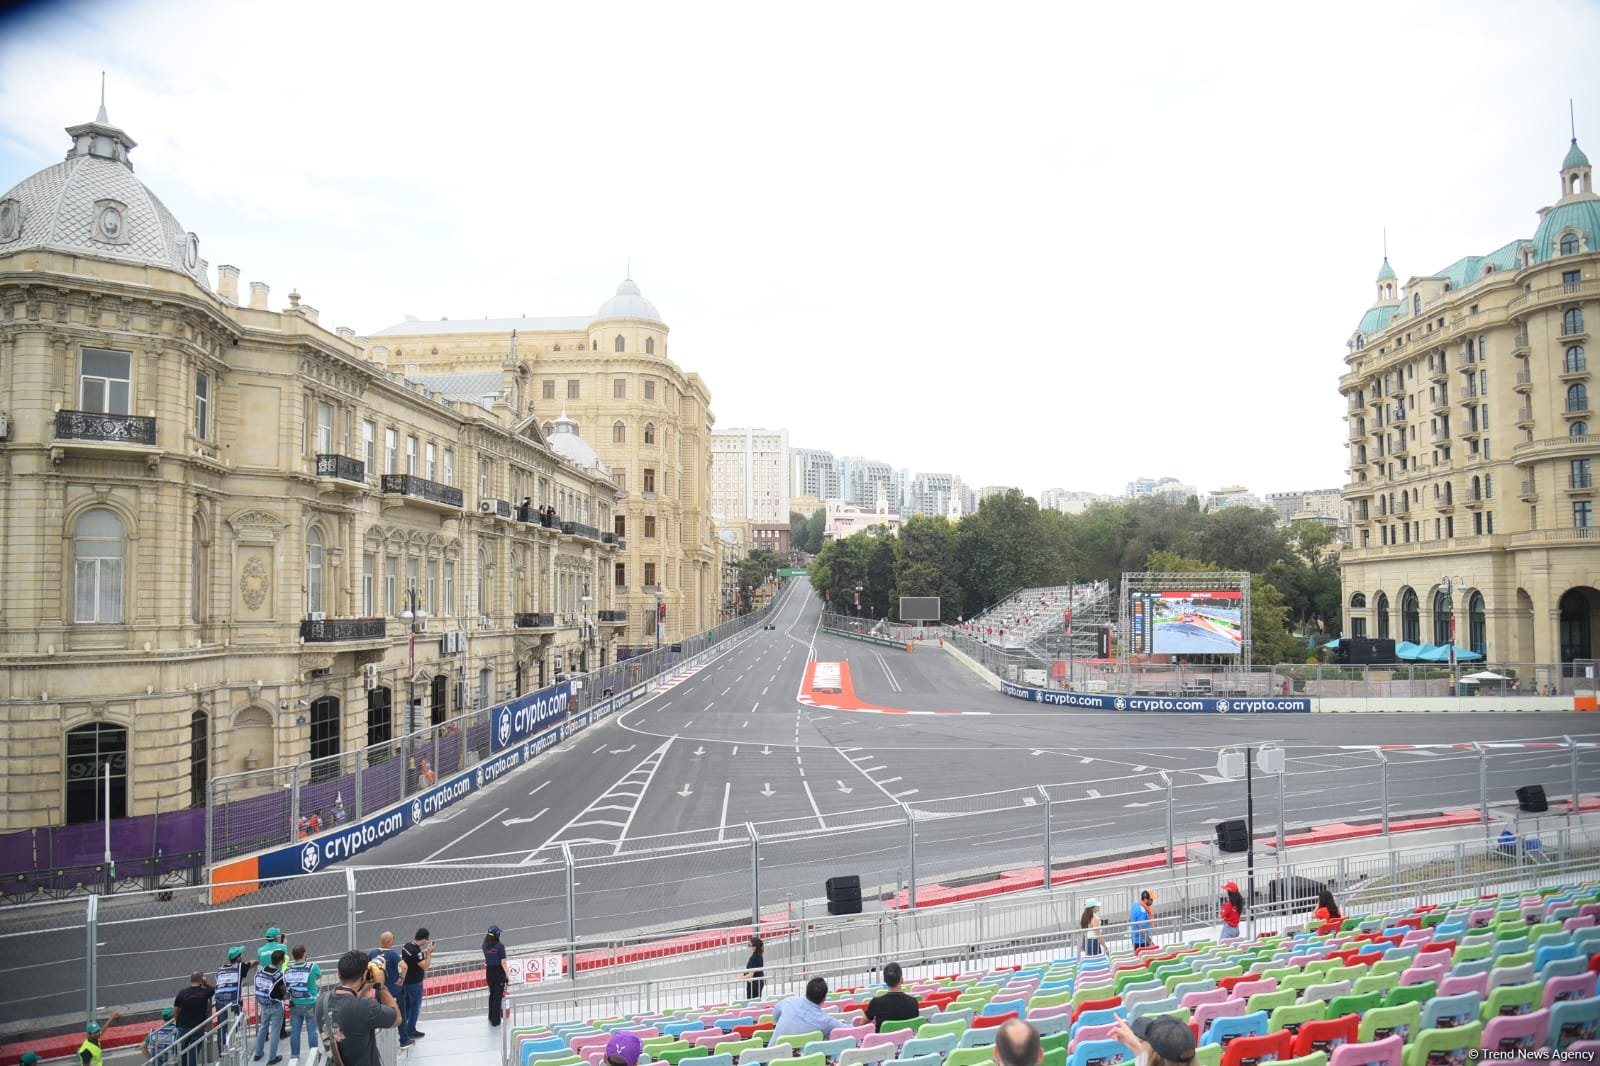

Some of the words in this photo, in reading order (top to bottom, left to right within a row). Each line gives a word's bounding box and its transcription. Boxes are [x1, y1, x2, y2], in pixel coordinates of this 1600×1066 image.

[515, 692, 567, 733] crypto.com
[1045, 693, 1102, 707] crypto.com
[1130, 699, 1203, 712] crypto.com
[1233, 699, 1304, 712] crypto.com
[530, 732, 558, 754] crypto.com
[484, 752, 520, 780] crypto.com
[423, 777, 471, 814] crypto.com
[324, 811, 402, 859] crypto.com
